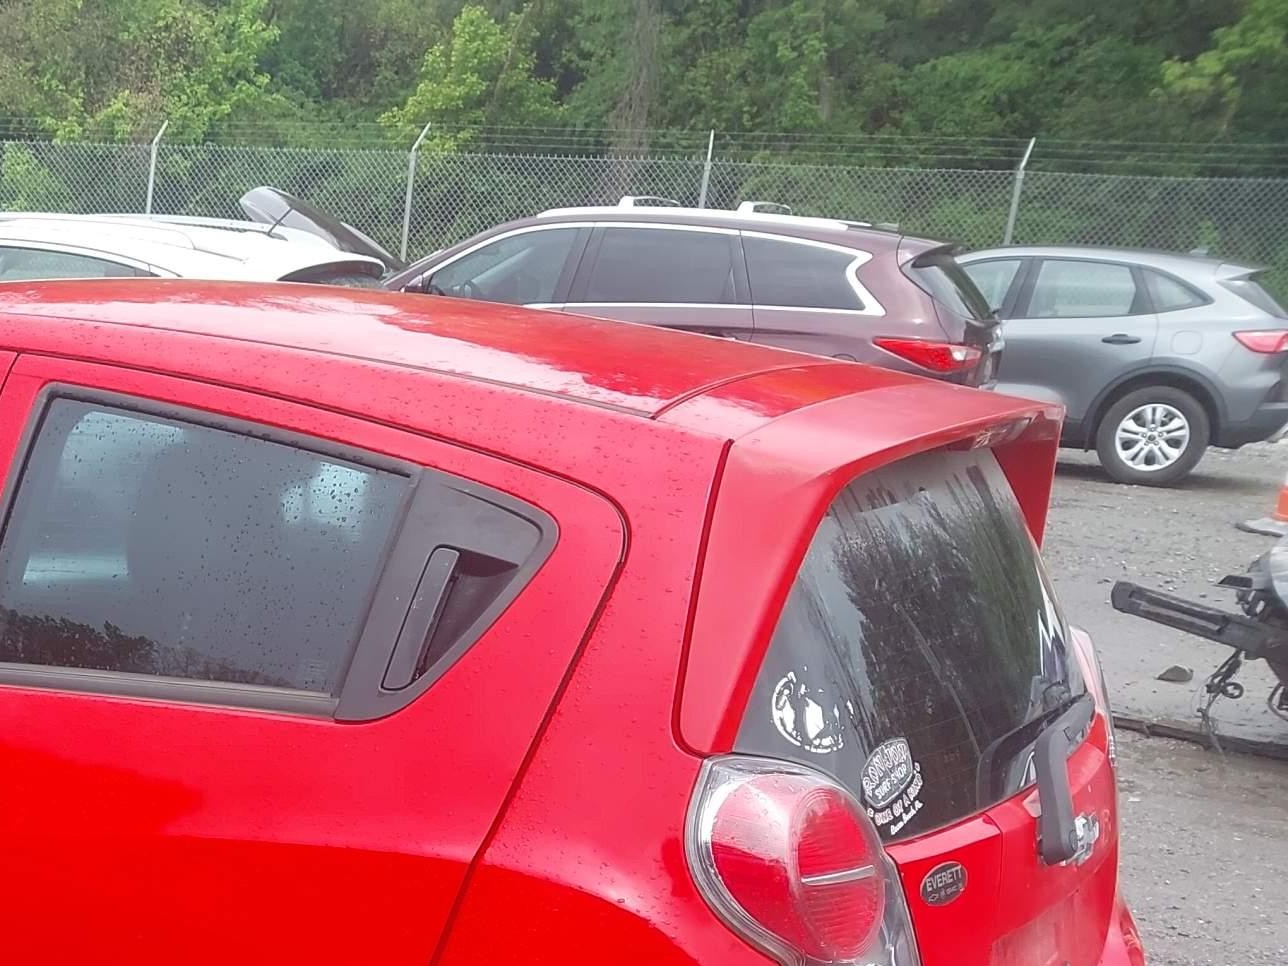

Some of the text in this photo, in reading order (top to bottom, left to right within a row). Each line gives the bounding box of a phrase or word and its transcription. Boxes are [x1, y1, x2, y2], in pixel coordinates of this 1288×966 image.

[862, 745, 886, 797] RON
[875, 778, 892, 799] SURF
[926, 866, 962, 892] EVERETT
